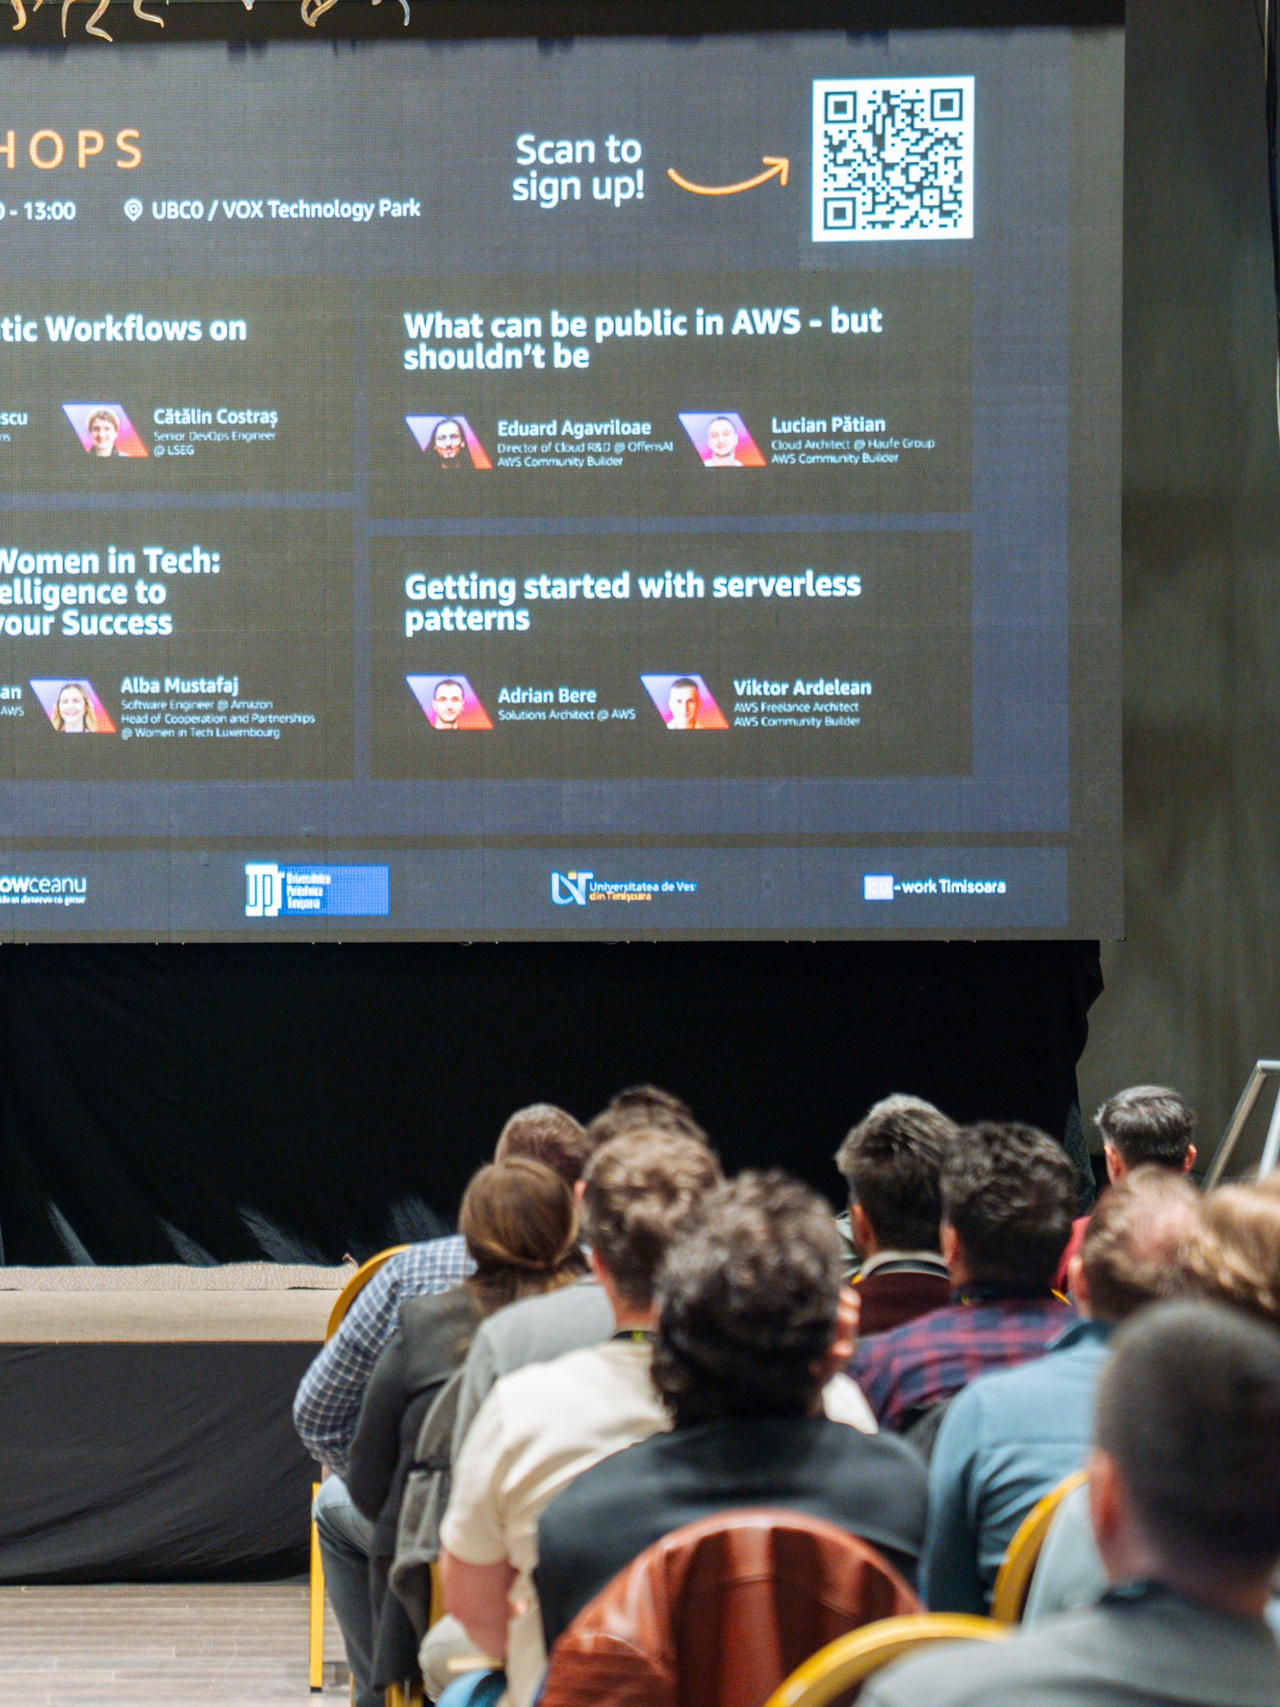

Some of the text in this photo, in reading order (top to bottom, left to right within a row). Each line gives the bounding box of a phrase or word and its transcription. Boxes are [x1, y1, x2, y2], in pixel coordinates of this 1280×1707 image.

[516, 133, 642, 166] Scan to
[512, 168, 645, 209] sign up!
[23, 201, 77, 221] 13:00
[207, 199, 219, 222] /
[222, 199, 264, 219] VOX
[266, 198, 376, 222] Technology
[379, 197, 421, 218] Park
[44, 313, 203, 343] Workflows
[209, 319, 247, 342] on
[403, 310, 484, 339] What
[490, 316, 542, 338] can
[550, 309, 588, 337] be
[595, 308, 688, 344] public
[695, 307, 724, 336] in
[731, 307, 802, 336] AWS
[831, 305, 883, 334] but
[553, 341, 590, 369] be
[497, 418, 652, 440] Eduard Agavriloae
[771, 416, 827, 434] Lucian
[153, 430, 276, 443] Senior DevOps Engineer
[770, 437, 936, 452] Cloud Architect @ Haufe Group
[153, 444, 195, 458] @ LSEG
[497, 443, 538, 454] Director
[540, 441, 553, 453] of
[554, 441, 586, 453] Cloud
[587, 441, 611, 453] R&D
[613, 442, 626, 455] @
[497, 455, 624, 469] AWS Community Builder
[771, 452, 899, 465] AWS Community Builder
[107, 545, 136, 574] in
[142, 545, 221, 575] Tech:
[134, 579, 167, 605] to
[405, 569, 862, 607] Getting started with serverless
[61, 608, 173, 636] Success
[405, 604, 531, 637] patterns
[120, 675, 239, 697] Alba Mustafaj
[497, 686, 597, 704] Adrian Bere
[733, 678, 872, 696] Viktor Ardelean
[0, 705, 25, 717] AWS
[121, 699, 274, 712] Software Engineer @ Amazon
[733, 701, 859, 714] AWS Freelance Architect
[120, 712, 316, 725] Head of Cooperation and Partnerships
[497, 708, 636, 722] Solutions Architect @ AWS
[733, 716, 861, 729] AWS Community Builder
[121, 727, 133, 741] @
[134, 727, 175, 738] Women
[177, 729, 188, 738] in
[190, 727, 214, 738] Tech
[676, 881, 697, 892] Ves
[939, 879, 1007, 894] Timisoara
